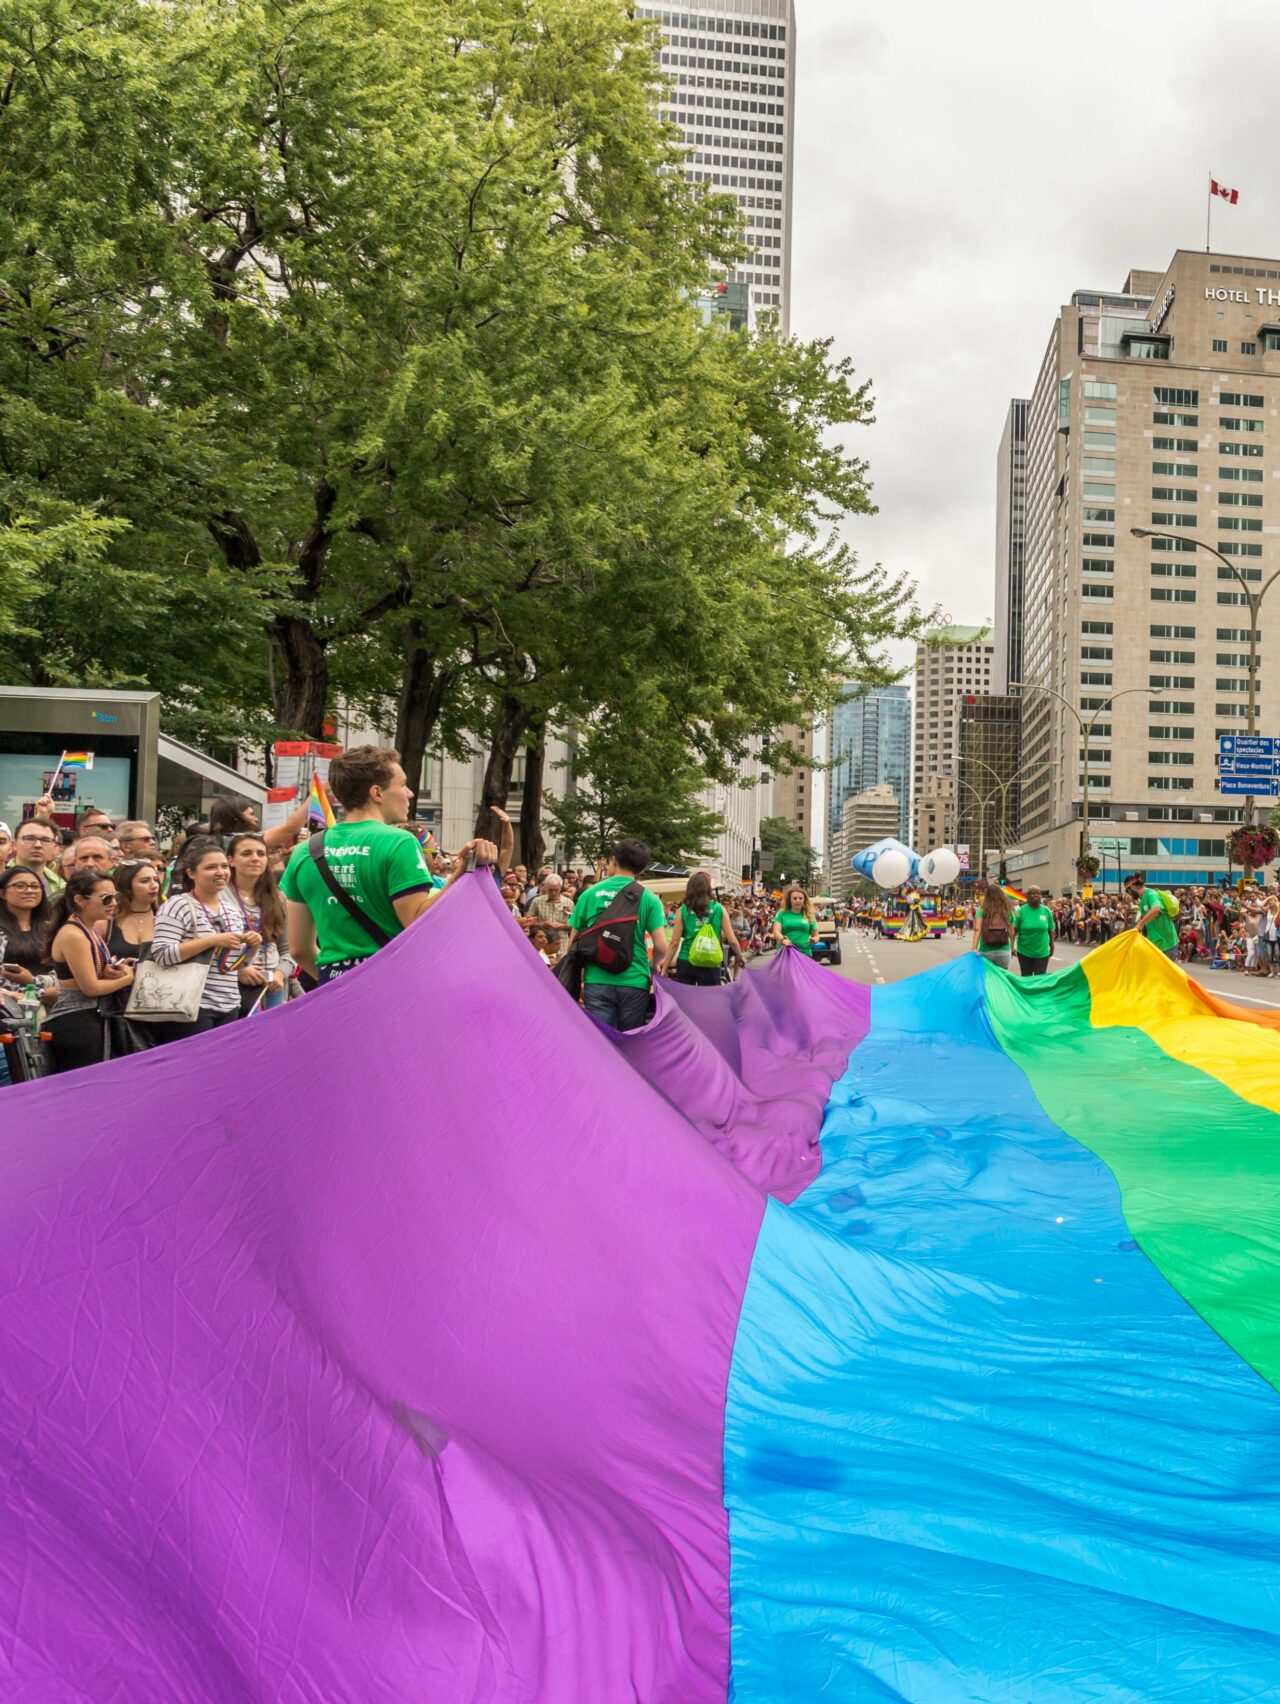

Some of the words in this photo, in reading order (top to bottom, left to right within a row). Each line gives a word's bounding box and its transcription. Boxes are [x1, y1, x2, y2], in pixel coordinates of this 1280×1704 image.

[1205, 285, 1250, 304] HÔTEL
[1236, 738, 1259, 746] Quartier
[1237, 781, 1270, 790] Bonaventure
[324, 845, 371, 857] ÉNÉVOLE
[329, 863, 355, 874] ERTÉ
